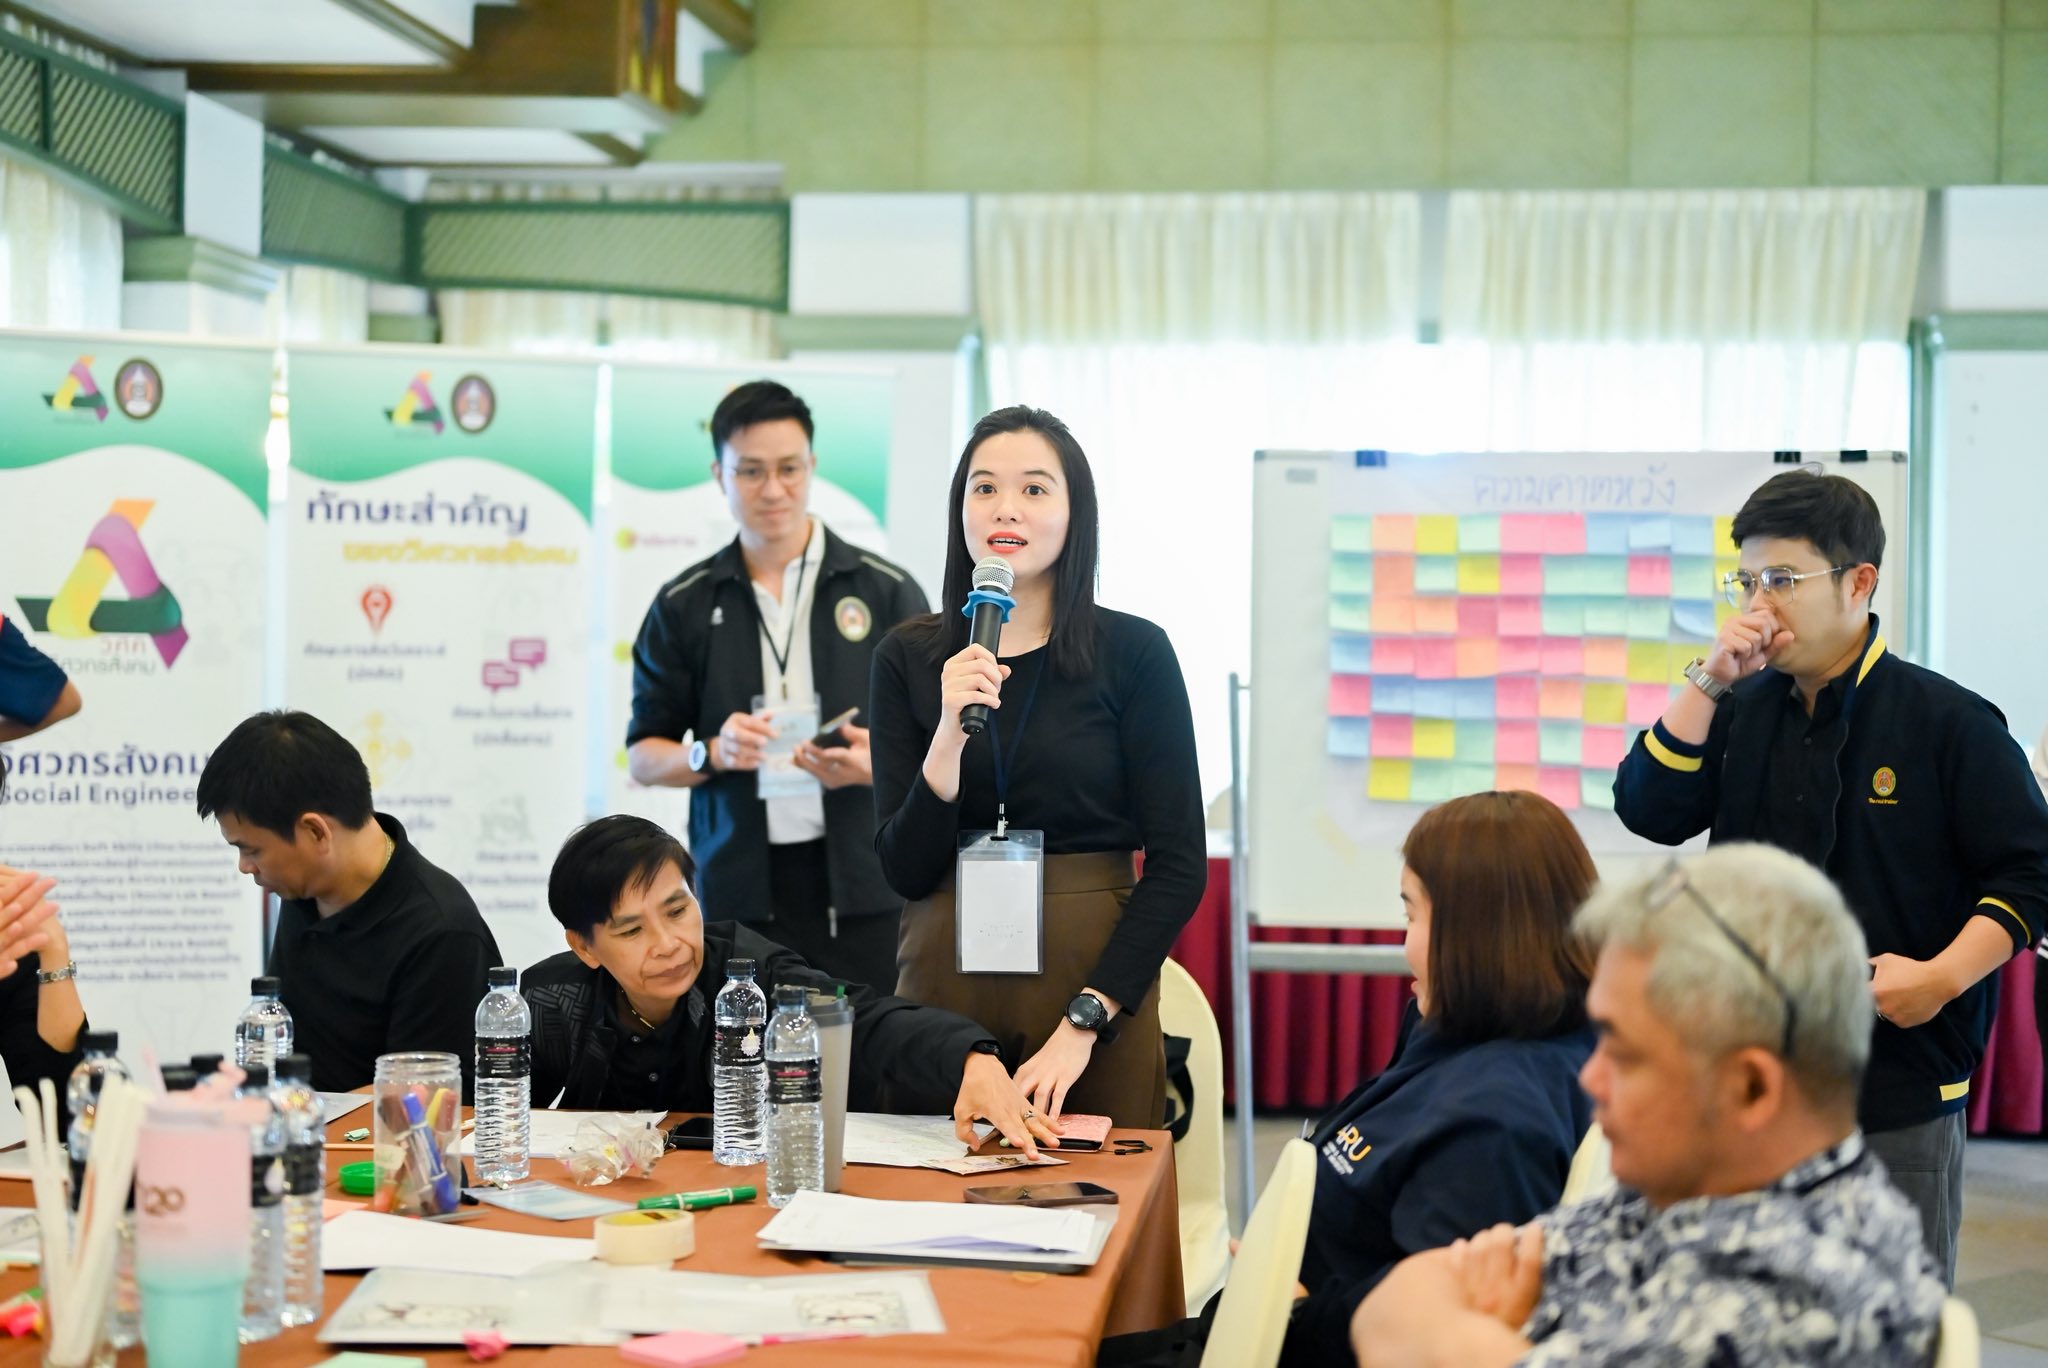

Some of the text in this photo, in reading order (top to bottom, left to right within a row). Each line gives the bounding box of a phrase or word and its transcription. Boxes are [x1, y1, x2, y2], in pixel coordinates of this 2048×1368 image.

[307, 489, 528, 535] ทักษะสำคัญ
[89, 783, 198, 809] Enginee
